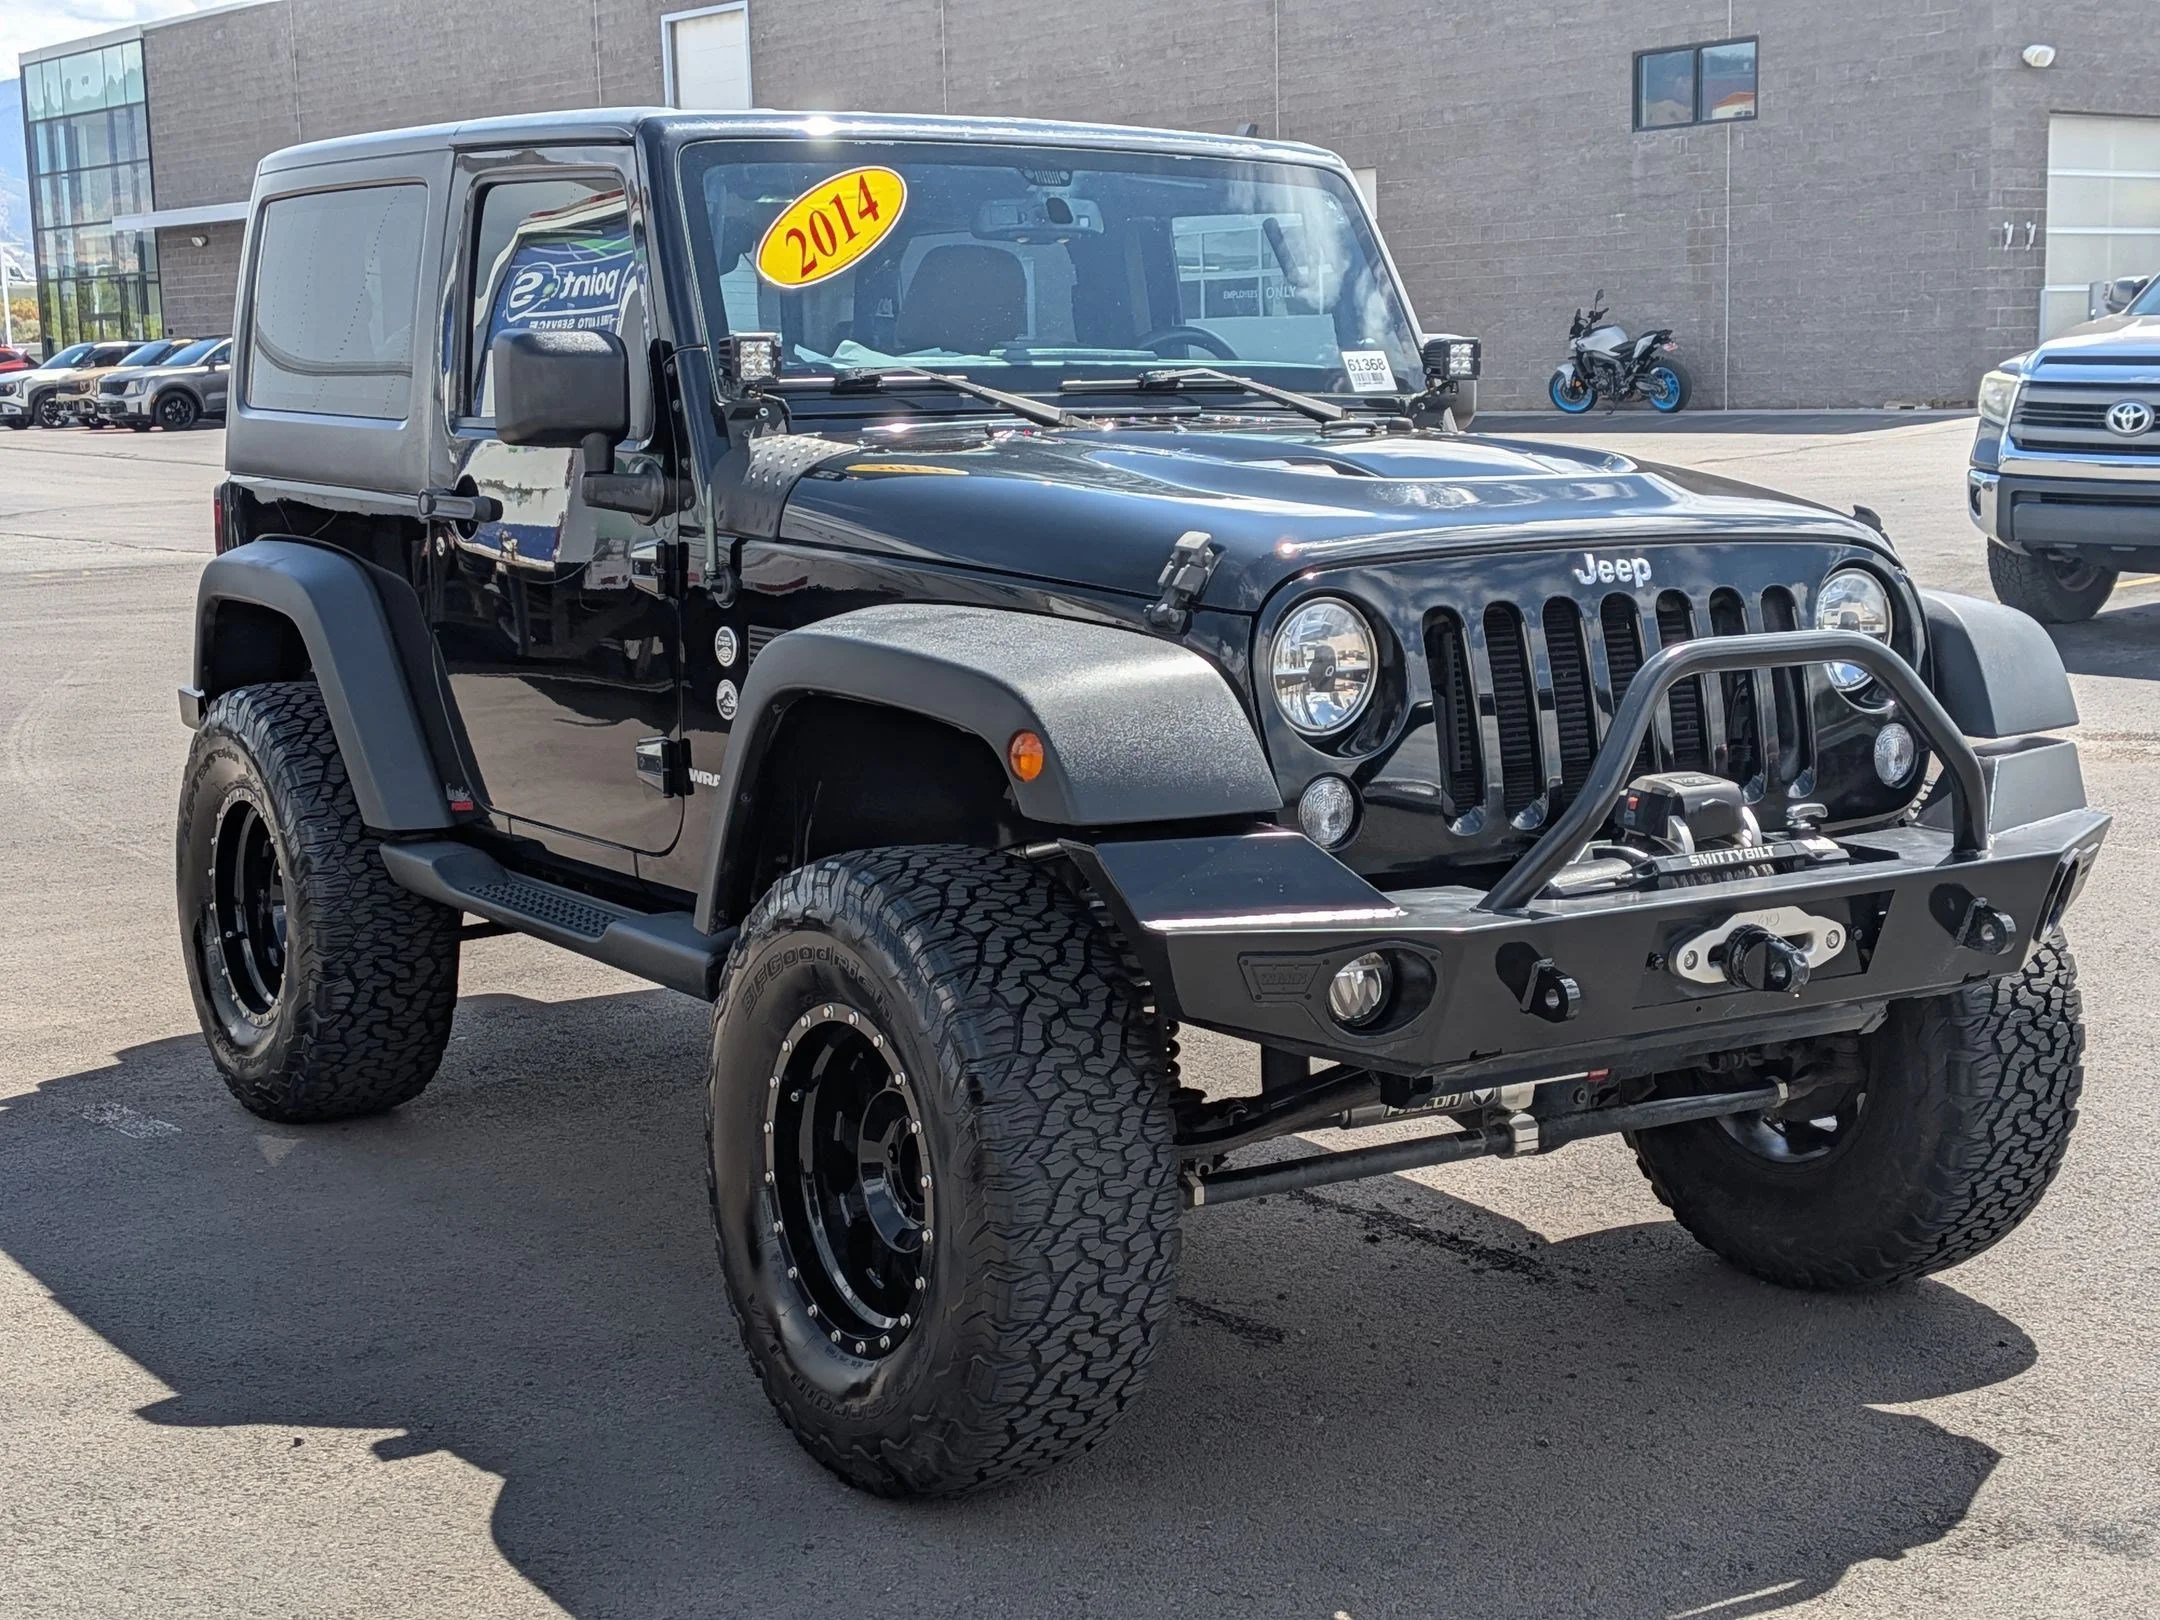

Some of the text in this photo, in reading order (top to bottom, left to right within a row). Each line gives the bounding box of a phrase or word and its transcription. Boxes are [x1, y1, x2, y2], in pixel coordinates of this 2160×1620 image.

[786, 175, 880, 278] 2014
[1266, 286, 1297, 299] ONLY
[1347, 358, 1387, 372] 61368
[1573, 553, 1652, 588] Jeep
[1688, 845, 1774, 867] SMITTYBILT
